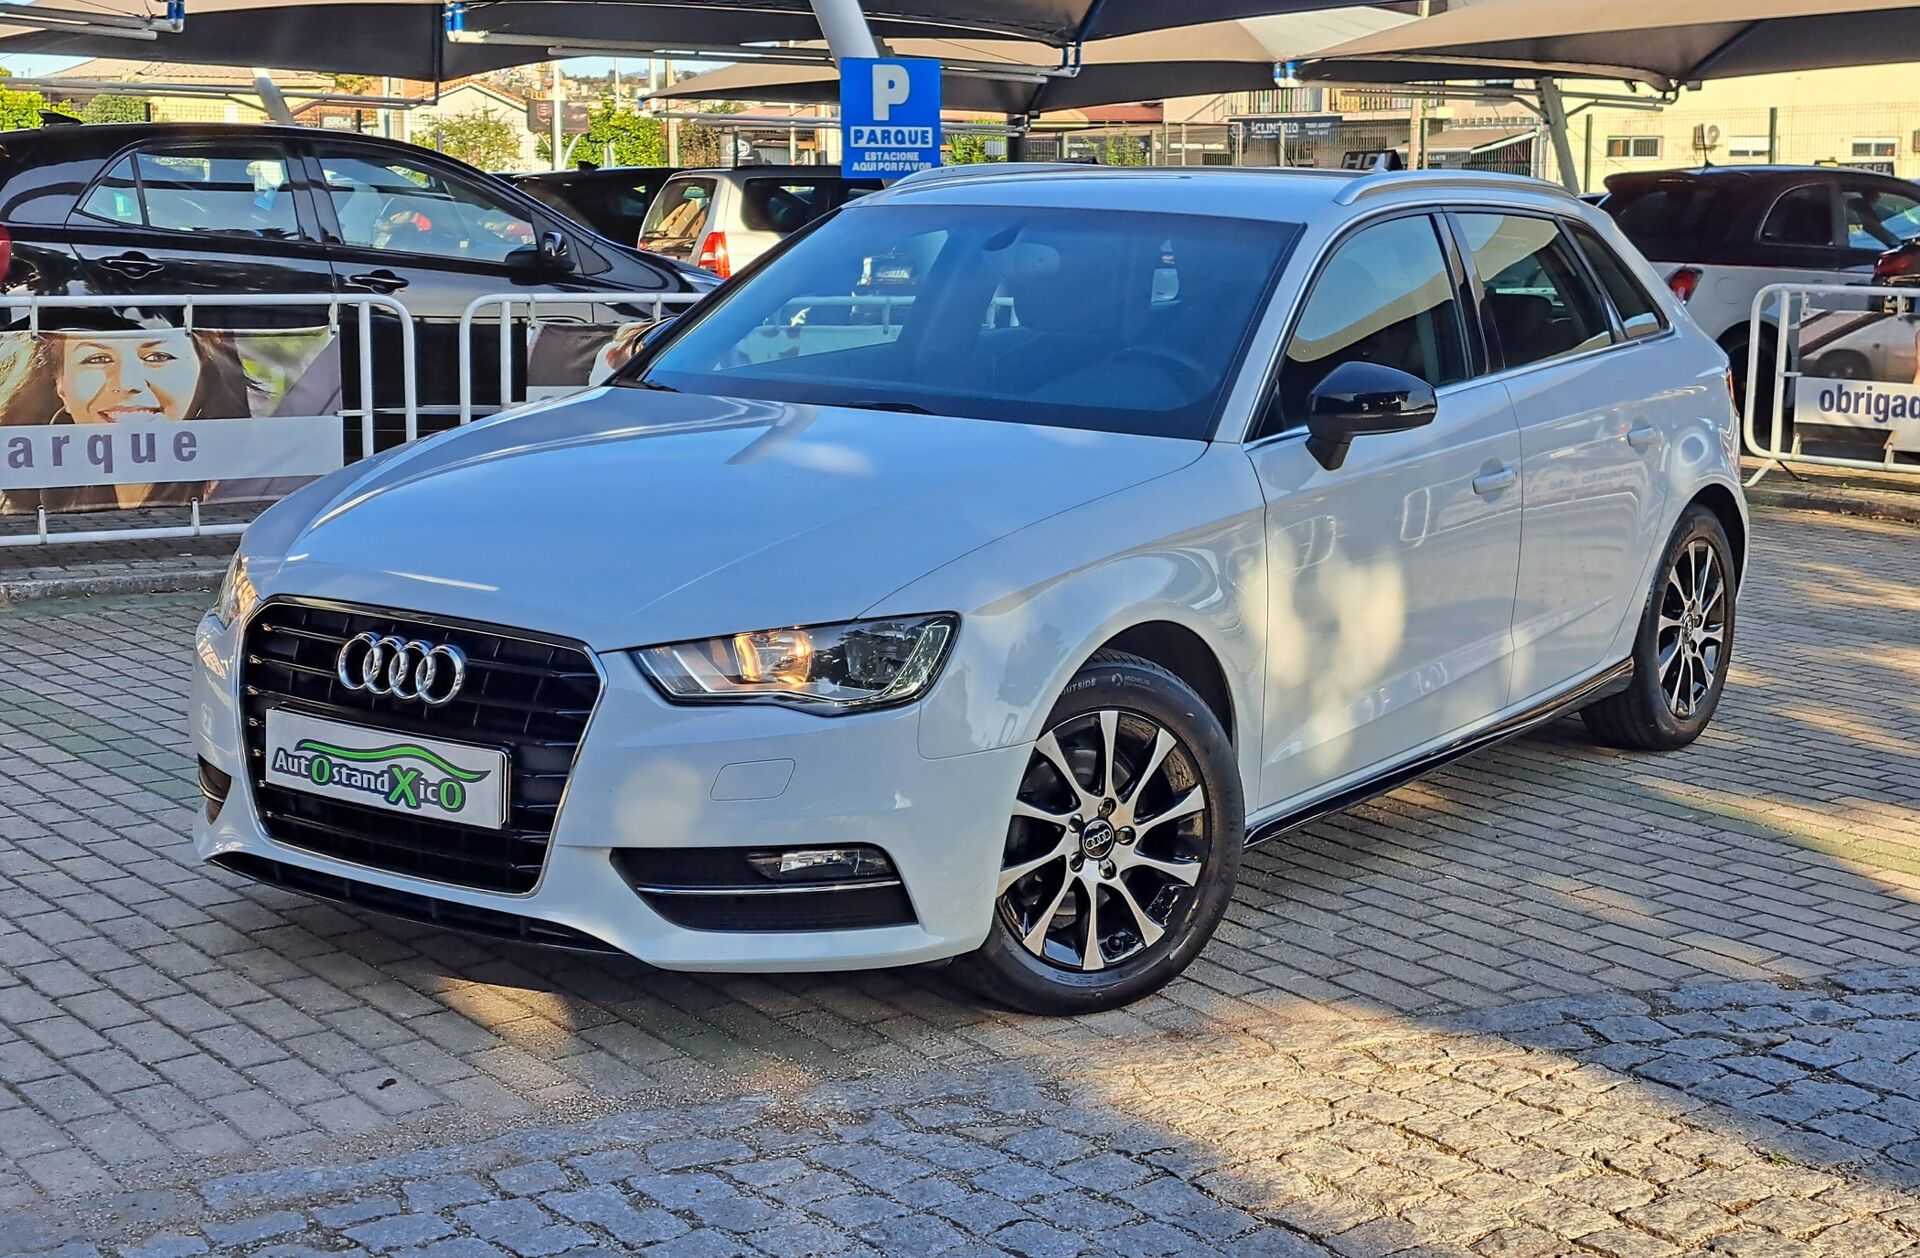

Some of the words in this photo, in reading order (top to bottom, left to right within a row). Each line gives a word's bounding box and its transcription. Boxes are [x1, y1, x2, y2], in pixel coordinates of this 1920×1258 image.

[872, 64, 910, 121] P
[853, 129, 930, 145] PARQUE
[864, 151, 920, 161] ESTACIONE
[852, 162, 877, 172] AQUI
[877, 162, 899, 172] POR
[899, 162, 932, 172] FAVOR
[7, 430, 198, 474] arque
